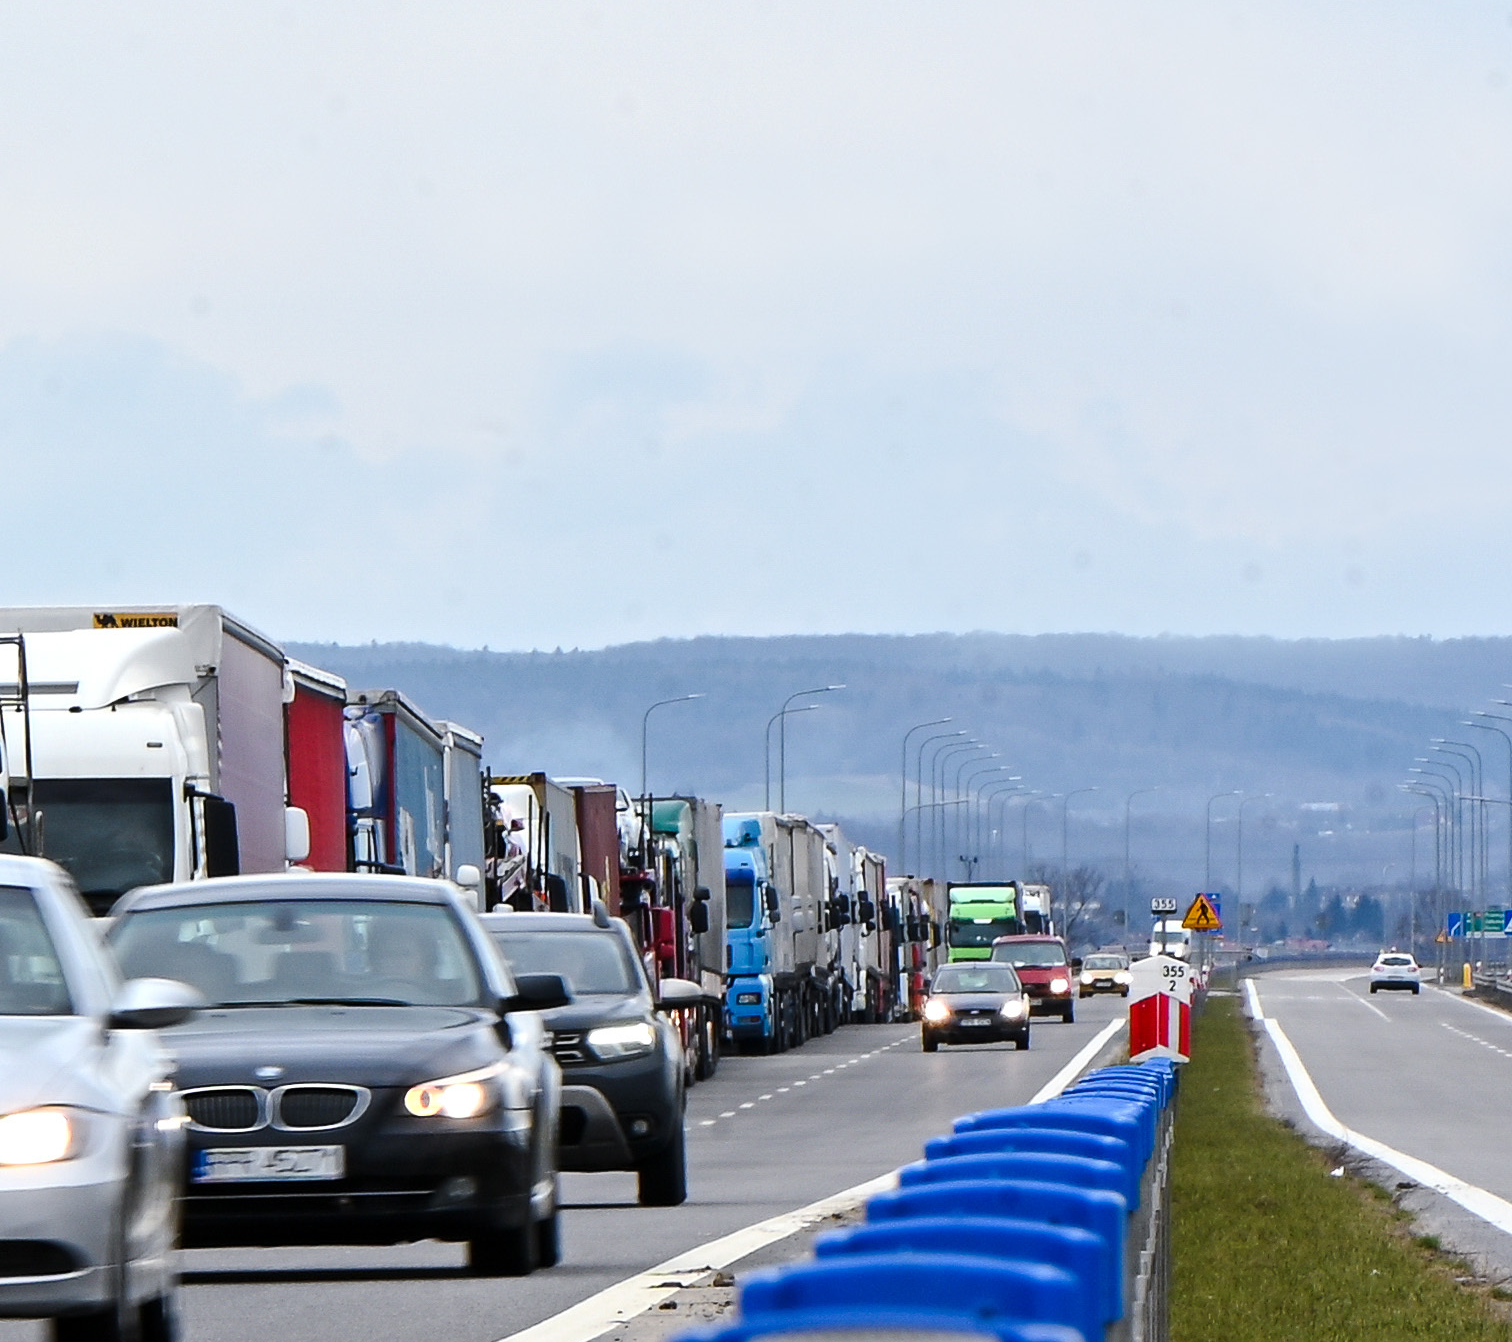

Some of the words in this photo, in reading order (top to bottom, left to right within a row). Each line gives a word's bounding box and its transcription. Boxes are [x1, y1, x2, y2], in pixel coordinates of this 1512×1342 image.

[120, 616, 179, 628] WIELTON
[1153, 898, 1175, 910] 355
[1162, 964, 1185, 978] 355
[1169, 980, 1177, 992] 2
